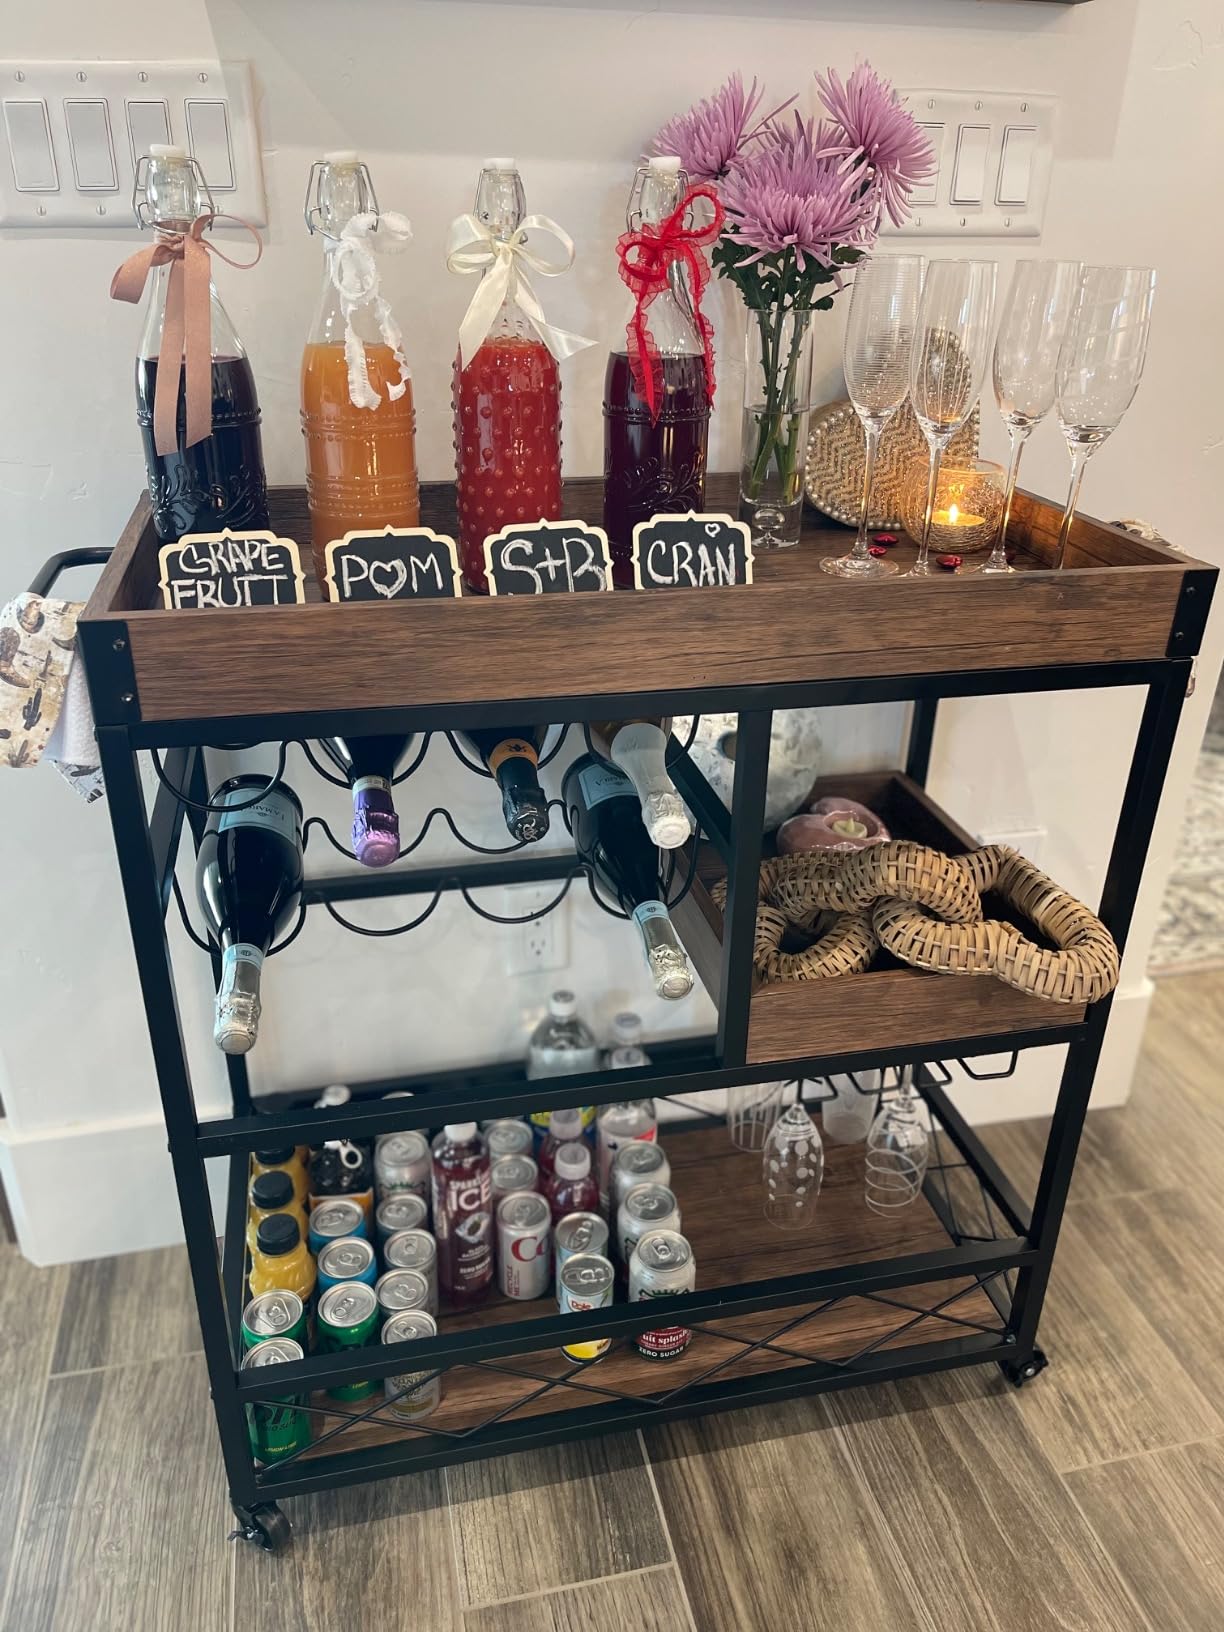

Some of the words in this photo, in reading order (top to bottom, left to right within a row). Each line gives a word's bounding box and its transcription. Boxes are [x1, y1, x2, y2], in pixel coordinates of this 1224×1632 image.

[179, 539, 285, 576] GRAPE
[647, 539, 736, 588] CRAN
[450, 1183, 491, 1212] ICE
[570, 1300, 593, 1311] Dole
[638, 1346, 658, 1357] ZERO
[660, 1345, 684, 1358] SUGAR
